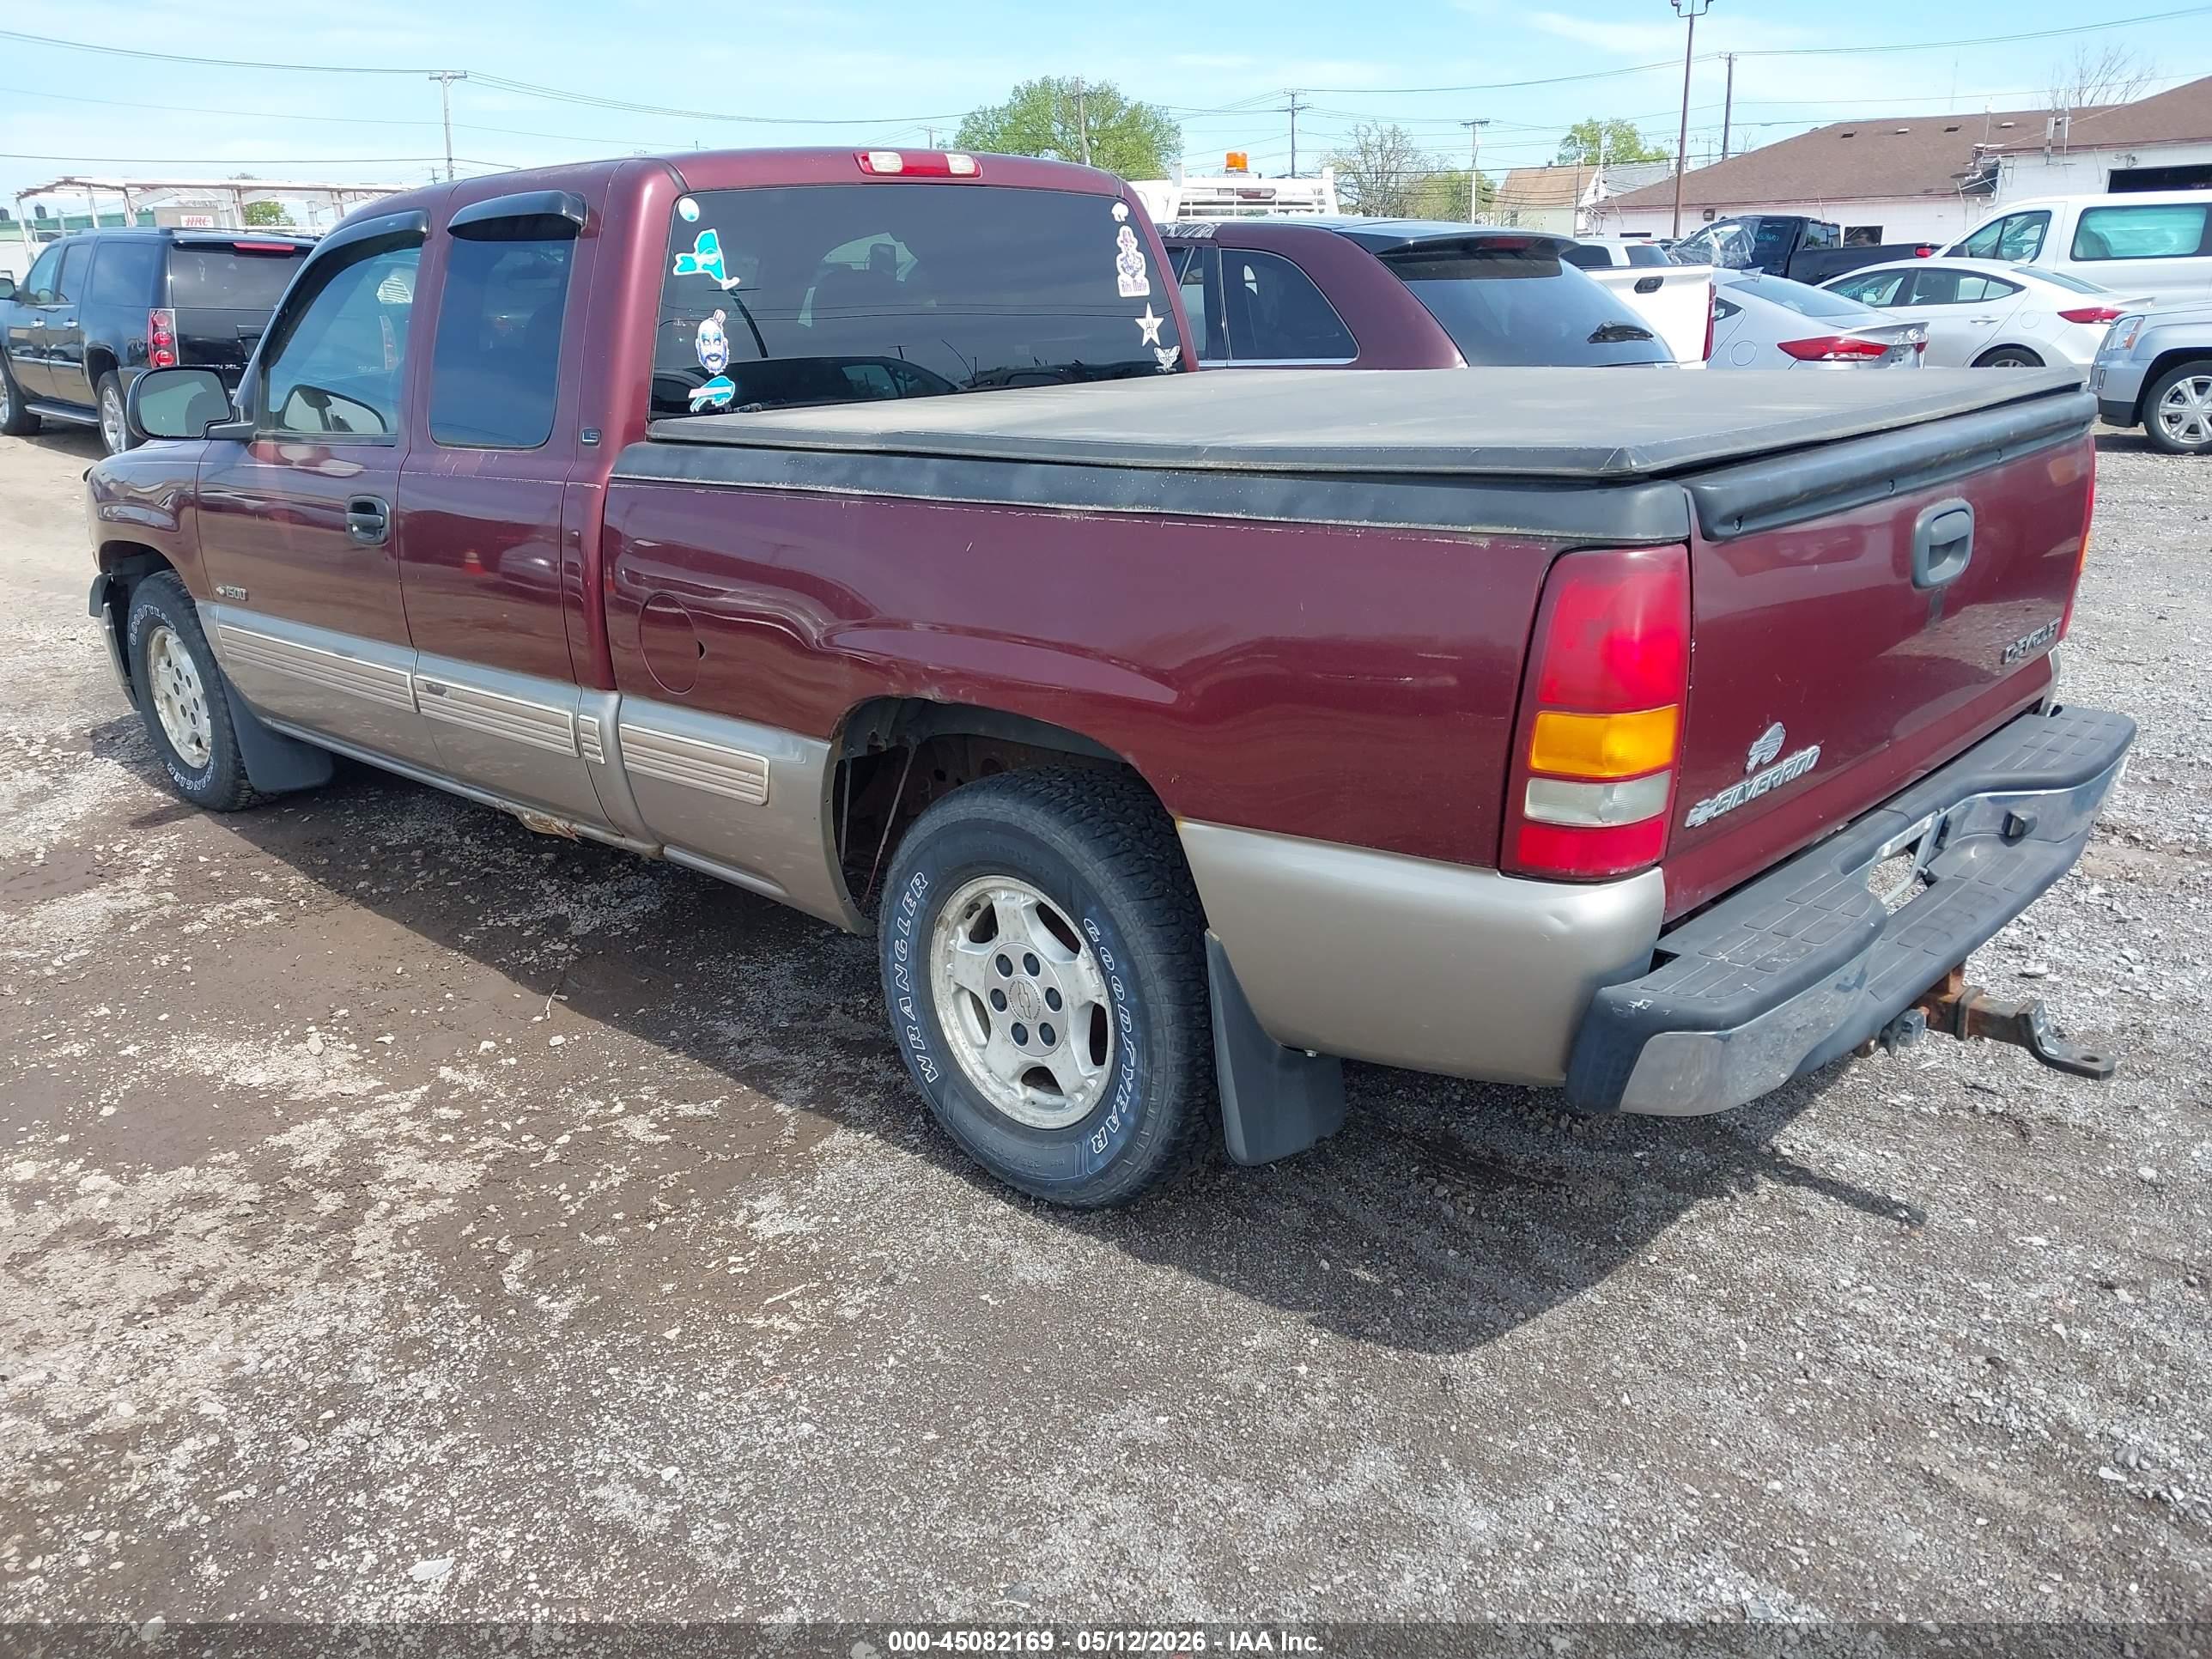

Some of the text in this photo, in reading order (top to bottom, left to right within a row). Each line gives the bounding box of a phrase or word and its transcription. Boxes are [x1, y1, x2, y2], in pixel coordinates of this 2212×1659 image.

[582, 432, 599, 442] LS
[226, 586, 247, 600] 1500
[130, 605, 177, 646] GOODYEAR
[167, 756, 215, 791] WRANGLER
[1713, 744, 1821, 817] SILVERADO
[894, 872, 939, 1084] WRANGLER
[1083, 918, 1137, 1154] GOODYEAR
